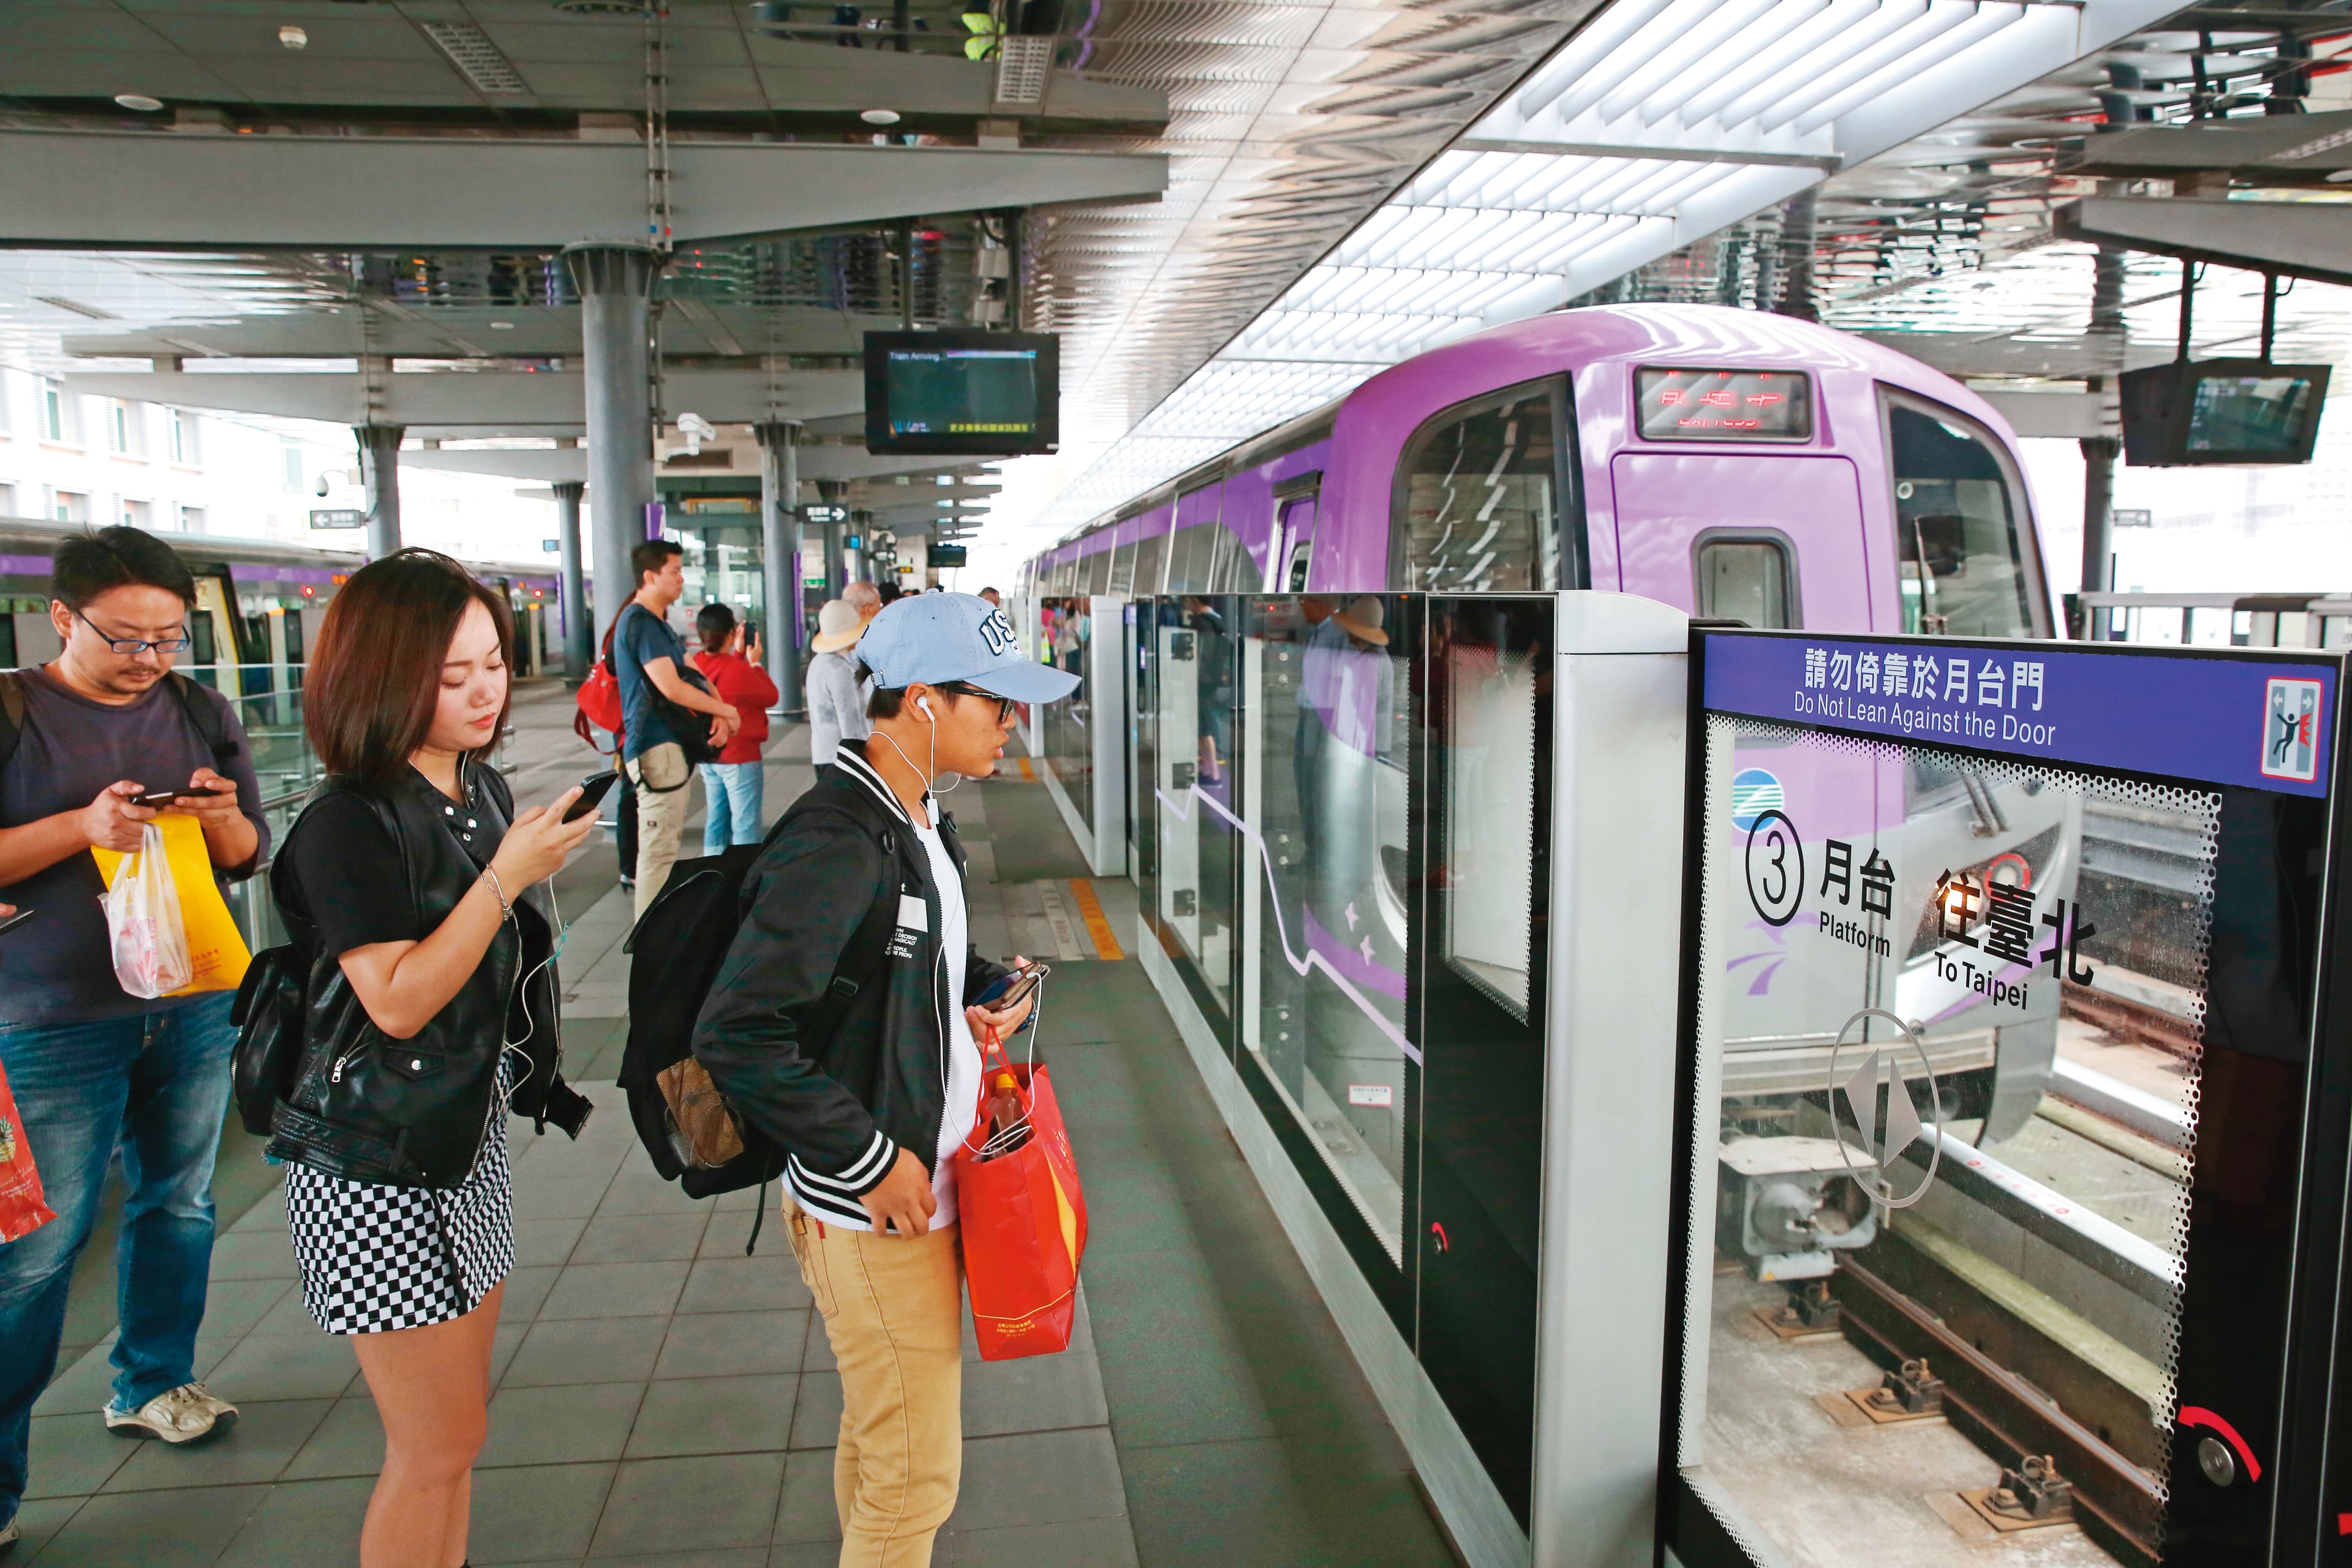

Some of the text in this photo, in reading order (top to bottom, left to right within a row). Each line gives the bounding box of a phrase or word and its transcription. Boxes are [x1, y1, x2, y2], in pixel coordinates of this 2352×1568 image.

[1804, 647, 2045, 712] 請勿倚靠於月台門
[1795, 690, 2056, 746] Do Not Lean Against the Door
[1820, 838, 1896, 921] 月台
[1820, 910, 1891, 958] Platform
[1935, 867, 2096, 987] 往臺北
[1935, 951, 2028, 1010] To Taipei
